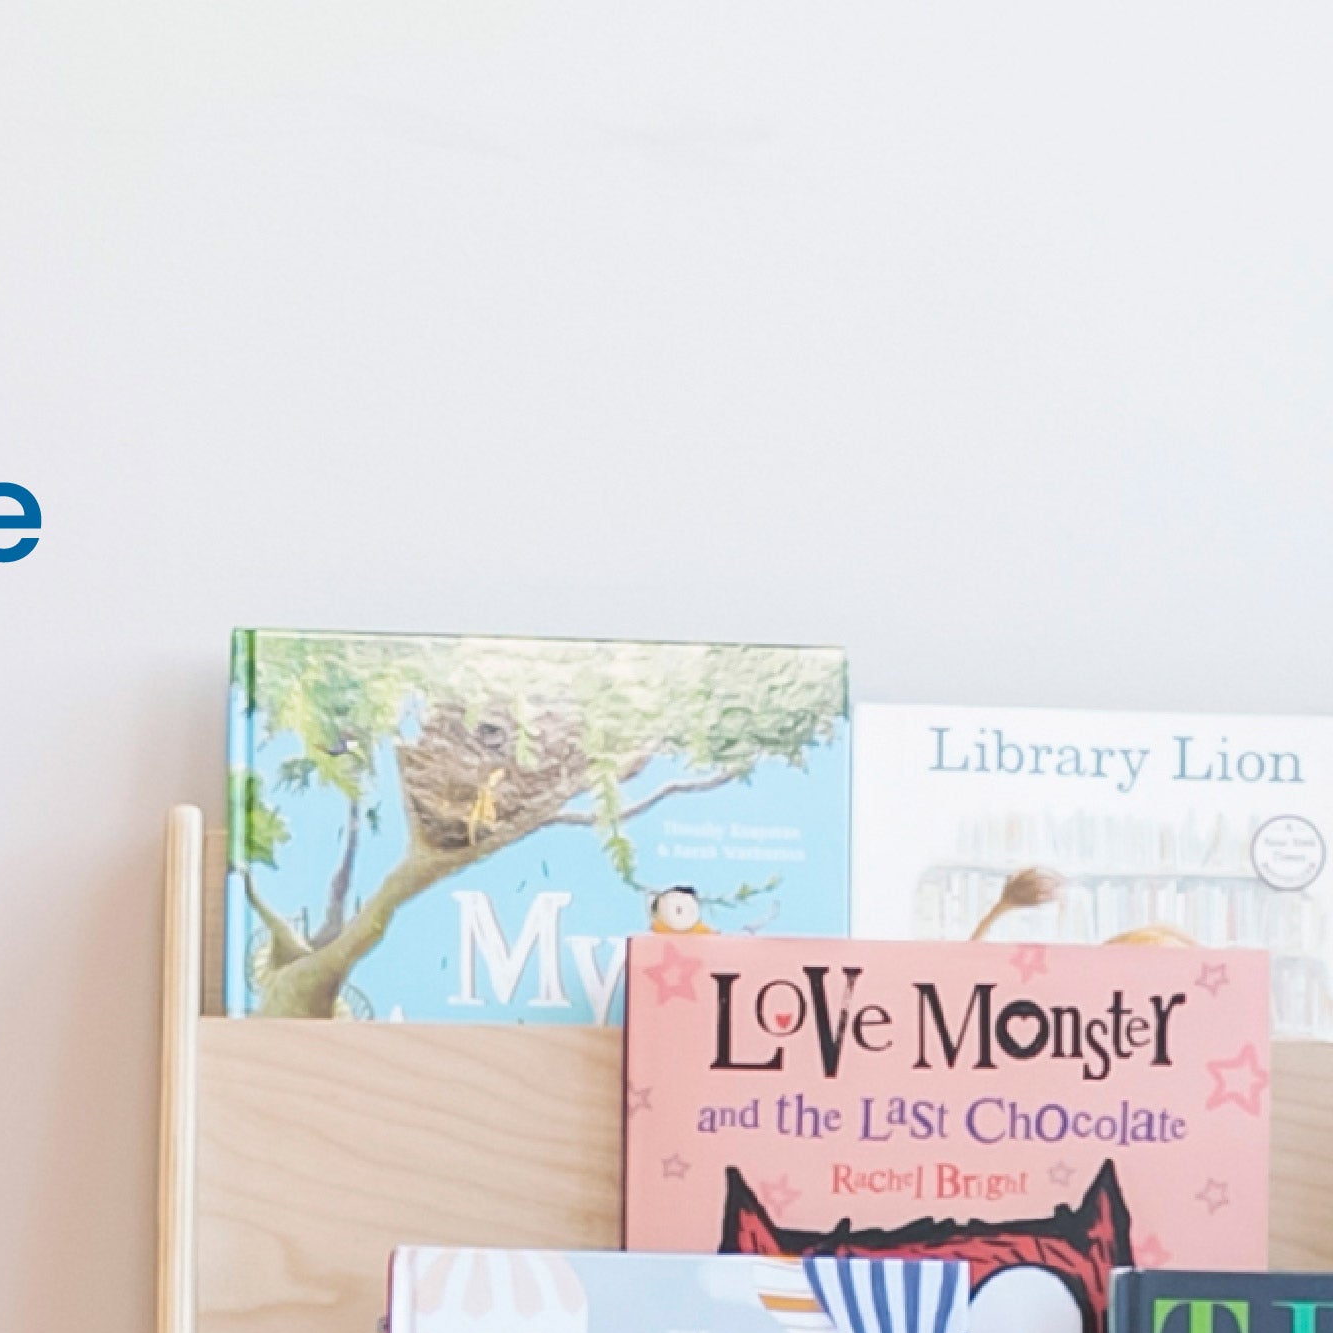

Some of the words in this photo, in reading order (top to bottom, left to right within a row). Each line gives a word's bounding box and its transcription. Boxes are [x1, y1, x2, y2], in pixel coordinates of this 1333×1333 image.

[928, 726, 1150, 793] Library
[1172, 735, 1306, 783] Lion
[697, 1098, 760, 1134] and
[776, 1094, 842, 1138] the
[831, 1163, 925, 1198] Rachel
[936, 1163, 1029, 1199] Bright
